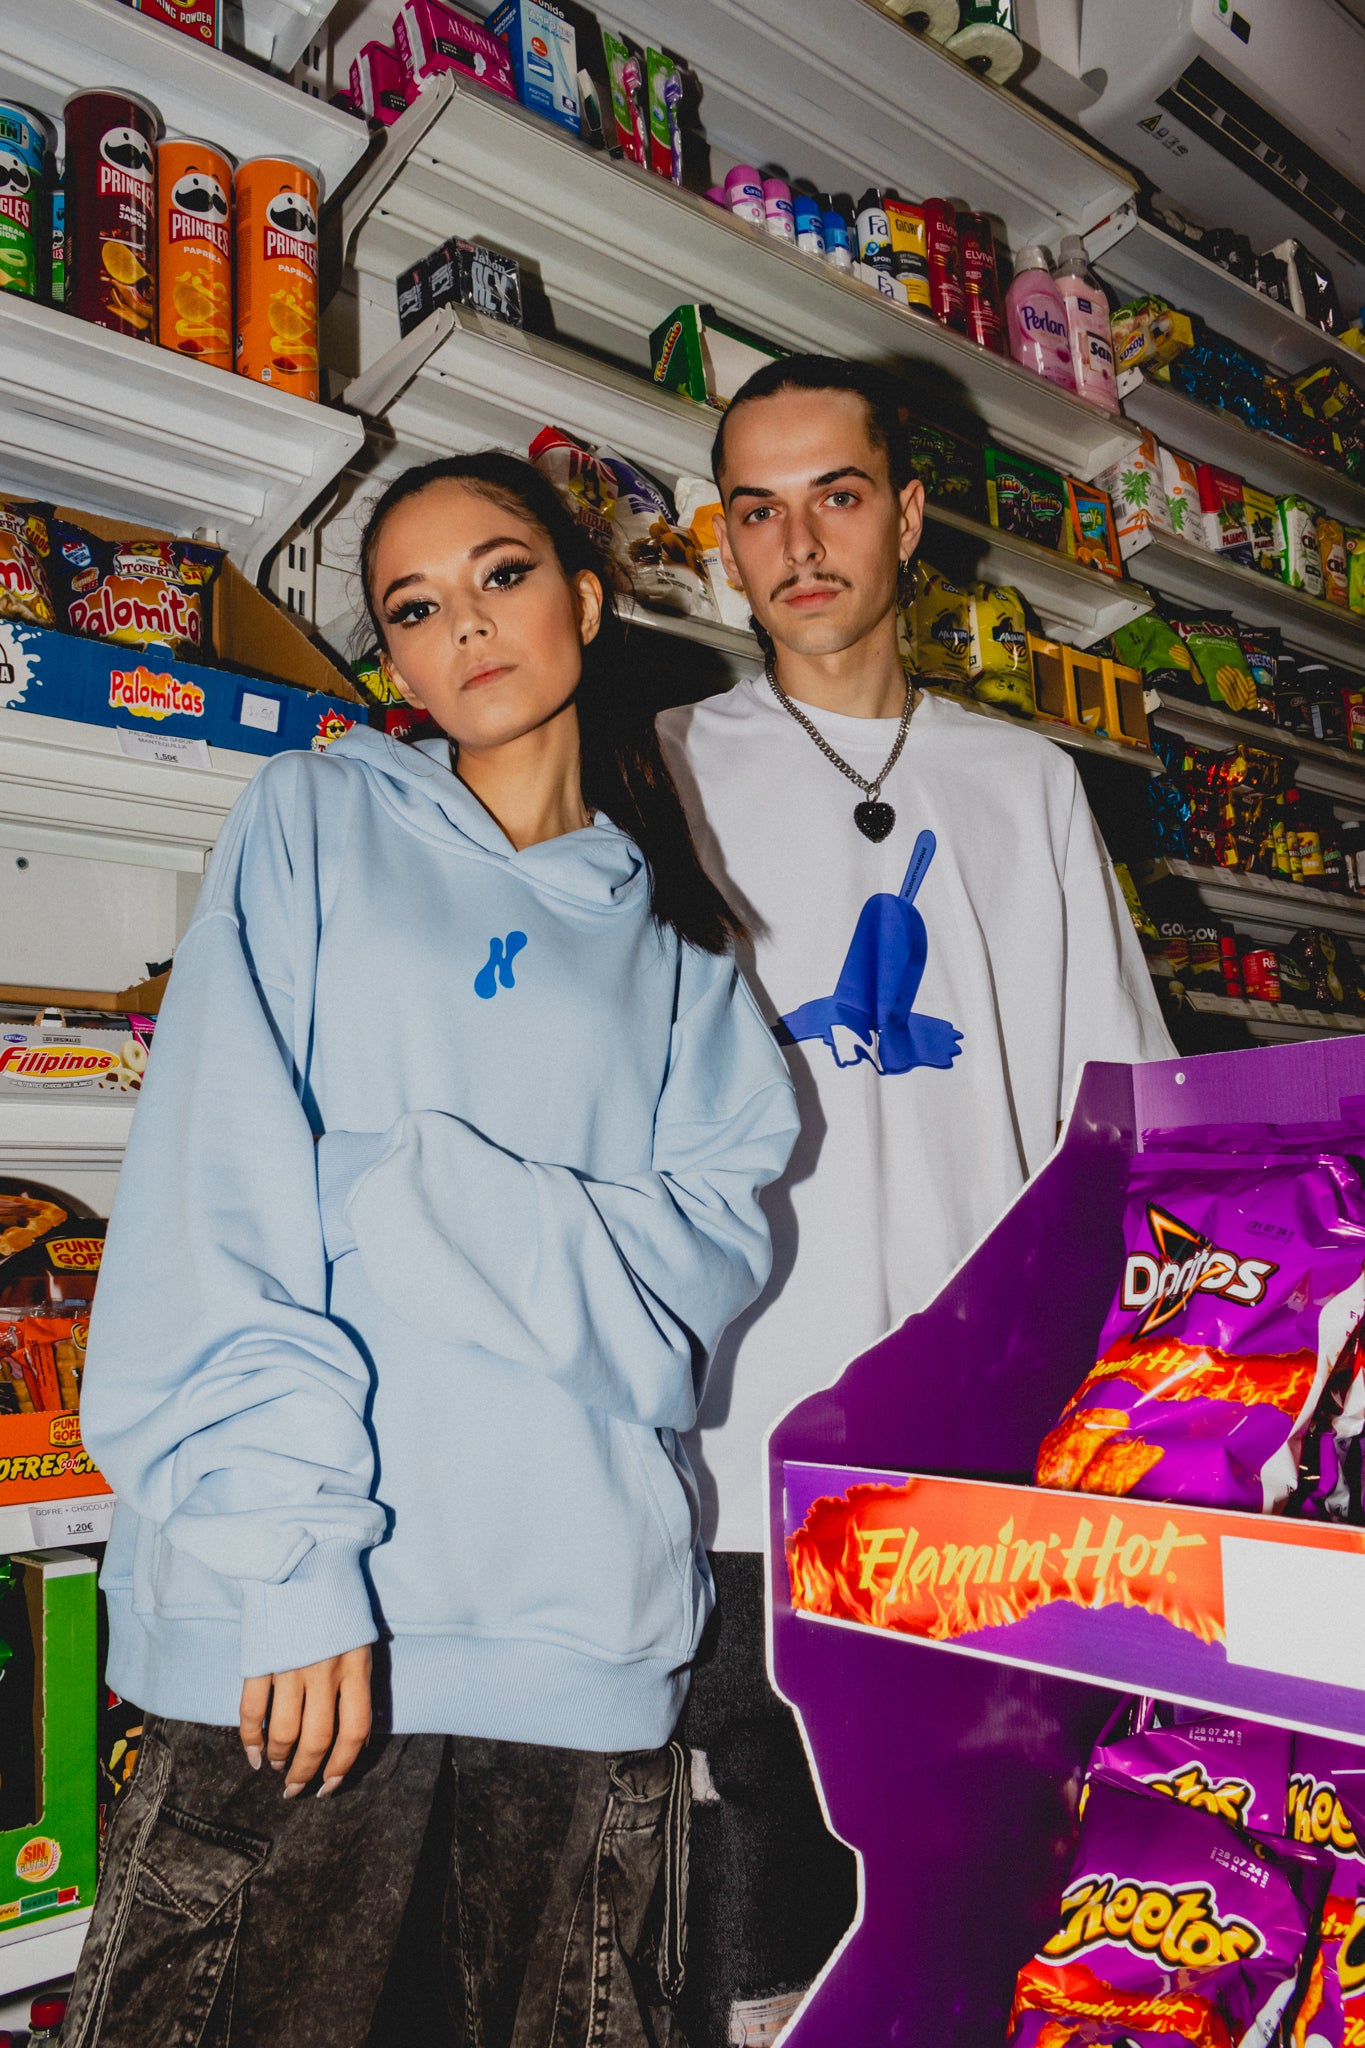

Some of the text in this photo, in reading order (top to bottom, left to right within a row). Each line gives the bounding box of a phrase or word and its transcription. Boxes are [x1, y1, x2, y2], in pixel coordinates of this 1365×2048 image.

[180, 12, 212, 25] POWDER
[448, 18, 501, 60] AUSONIA
[868, 214, 889, 236] Fa
[172, 213, 230, 258] PRINGLES
[183, 246, 222, 264] PAPRIKA
[267, 231, 318, 277] PRINGLES
[965, 249, 993, 265] ELVIVE
[278, 264, 313, 284] PAPRIKA
[877, 274, 895, 298] Fa
[1020, 305, 1068, 338] Perlan
[122, 562, 179, 581] TOSFRIT
[111, 671, 204, 714] Palomitas
[128, 730, 194, 745] PALOMITAS SABOR
[138, 737, 188, 750] MANTEQUILLA
[0, 1046, 113, 1074] Filipinos
[1123, 1248, 1272, 1312] Doritos
[61, 1459, 79, 1469] CON
[36, 1507, 62, 1516] GOFRE
[66, 1522, 93, 1535] 1,20€
[1061, 1514, 1207, 1582] Hot
[1194, 1727, 1235, 1738] 28 07 24
[23, 1842, 46, 1862] SIN
[1217, 1848, 1231, 1860] 28
[1232, 1855, 1247, 1867] 07
[1247, 1862, 1262, 1877] 24
